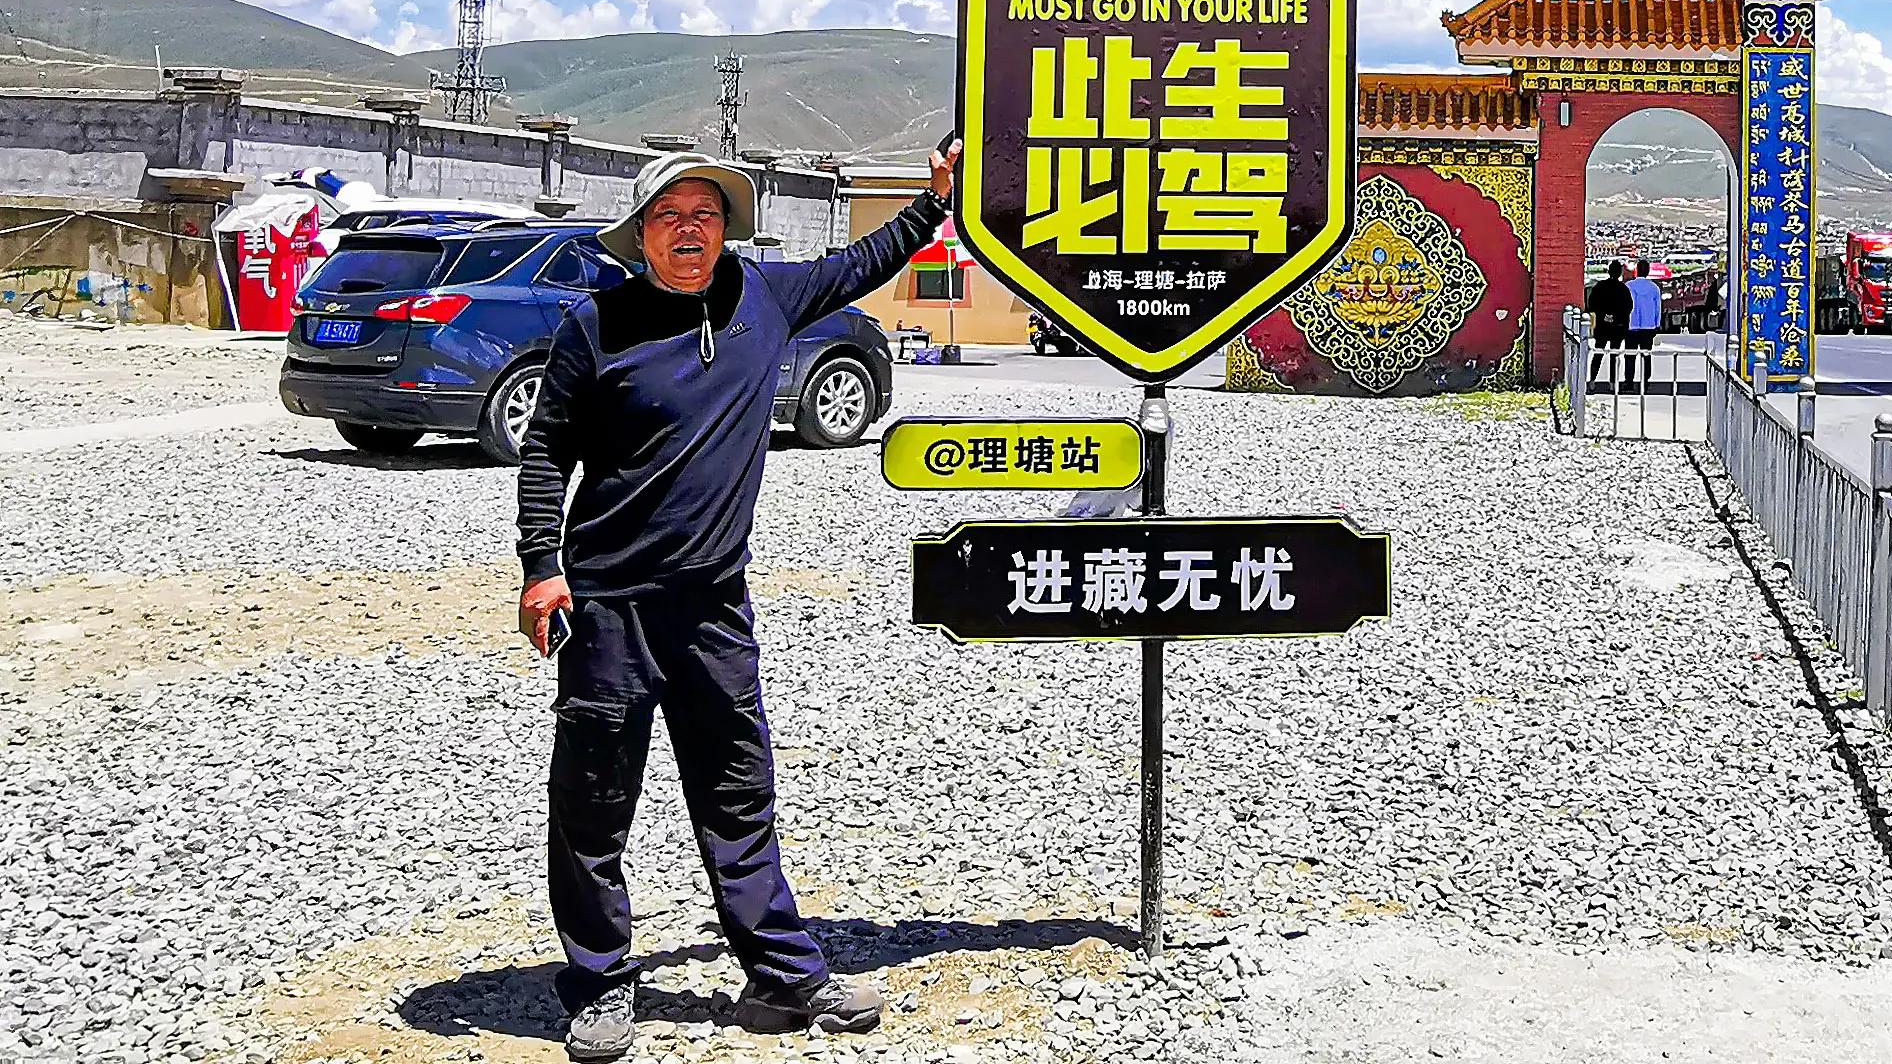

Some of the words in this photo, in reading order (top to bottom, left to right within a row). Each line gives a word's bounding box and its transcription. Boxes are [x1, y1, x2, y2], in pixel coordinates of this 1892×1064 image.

[1026, 36, 1291, 142] 此生
[1021, 147, 1289, 257] 必驾
[1116, 298, 1191, 319] 1800km
[923, 435, 1102, 477] @理塘站
[1007, 548, 1297, 615] 进藏无忧
